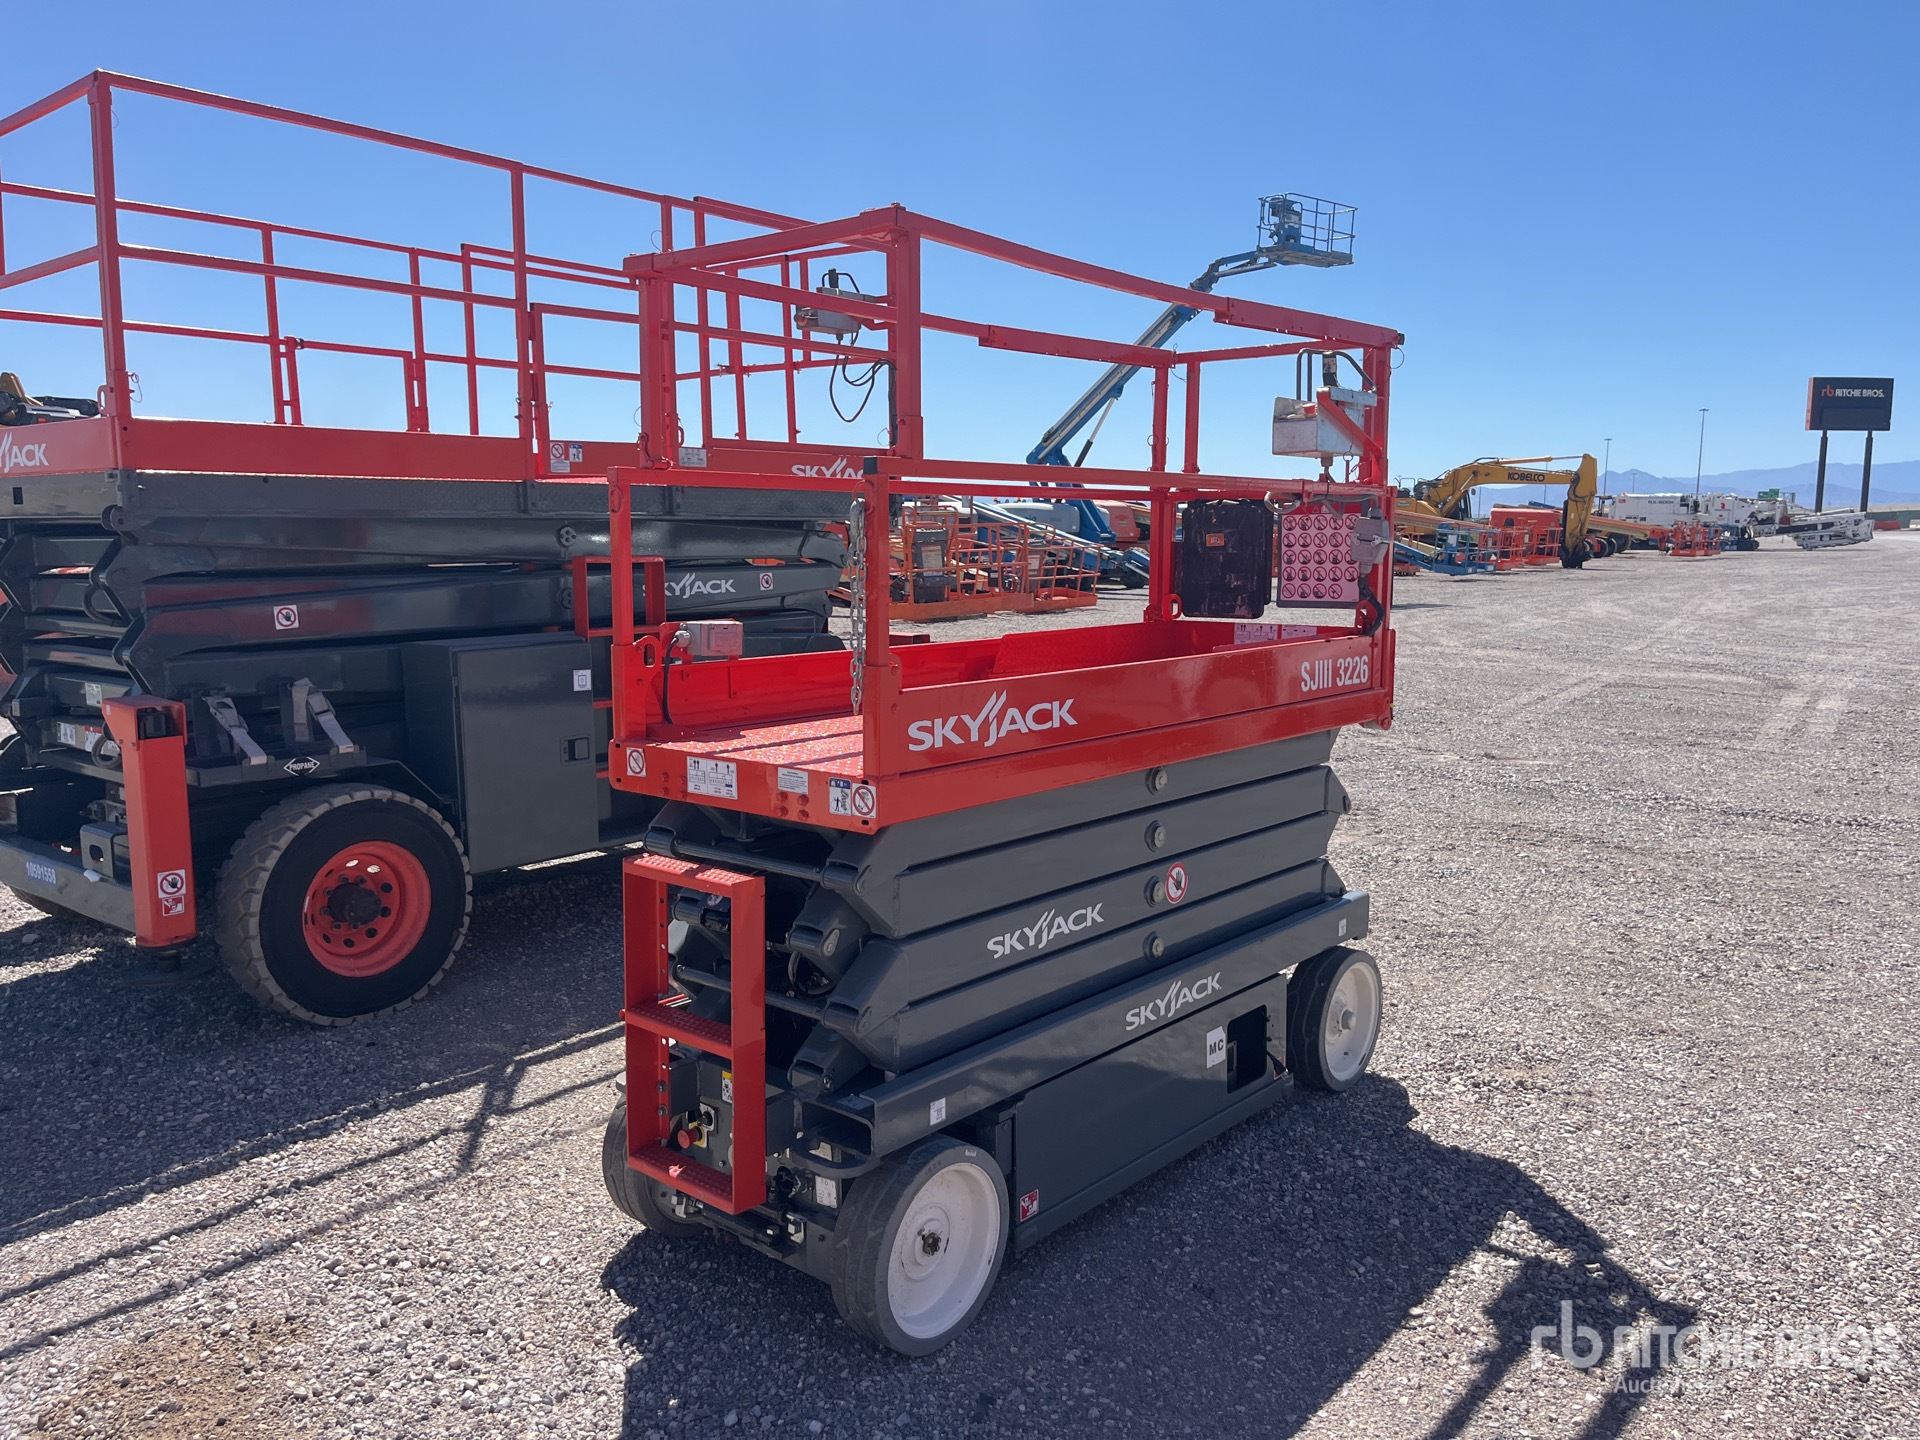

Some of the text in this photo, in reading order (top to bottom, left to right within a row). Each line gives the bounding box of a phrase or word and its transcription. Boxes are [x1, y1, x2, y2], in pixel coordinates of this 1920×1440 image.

[1835, 389, 1861, 397] RITCHIE
[1507, 472, 1546, 482] KOBELCO
[1301, 655, 1369, 692] SJIII 3226
[907, 689, 1078, 751] SKYJACK
[289, 761, 315, 771] PROPANE
[987, 903, 1104, 959] SKYJACK
[1125, 972, 1222, 1031] SKYJACK
[1209, 1038, 1224, 1056] MC
